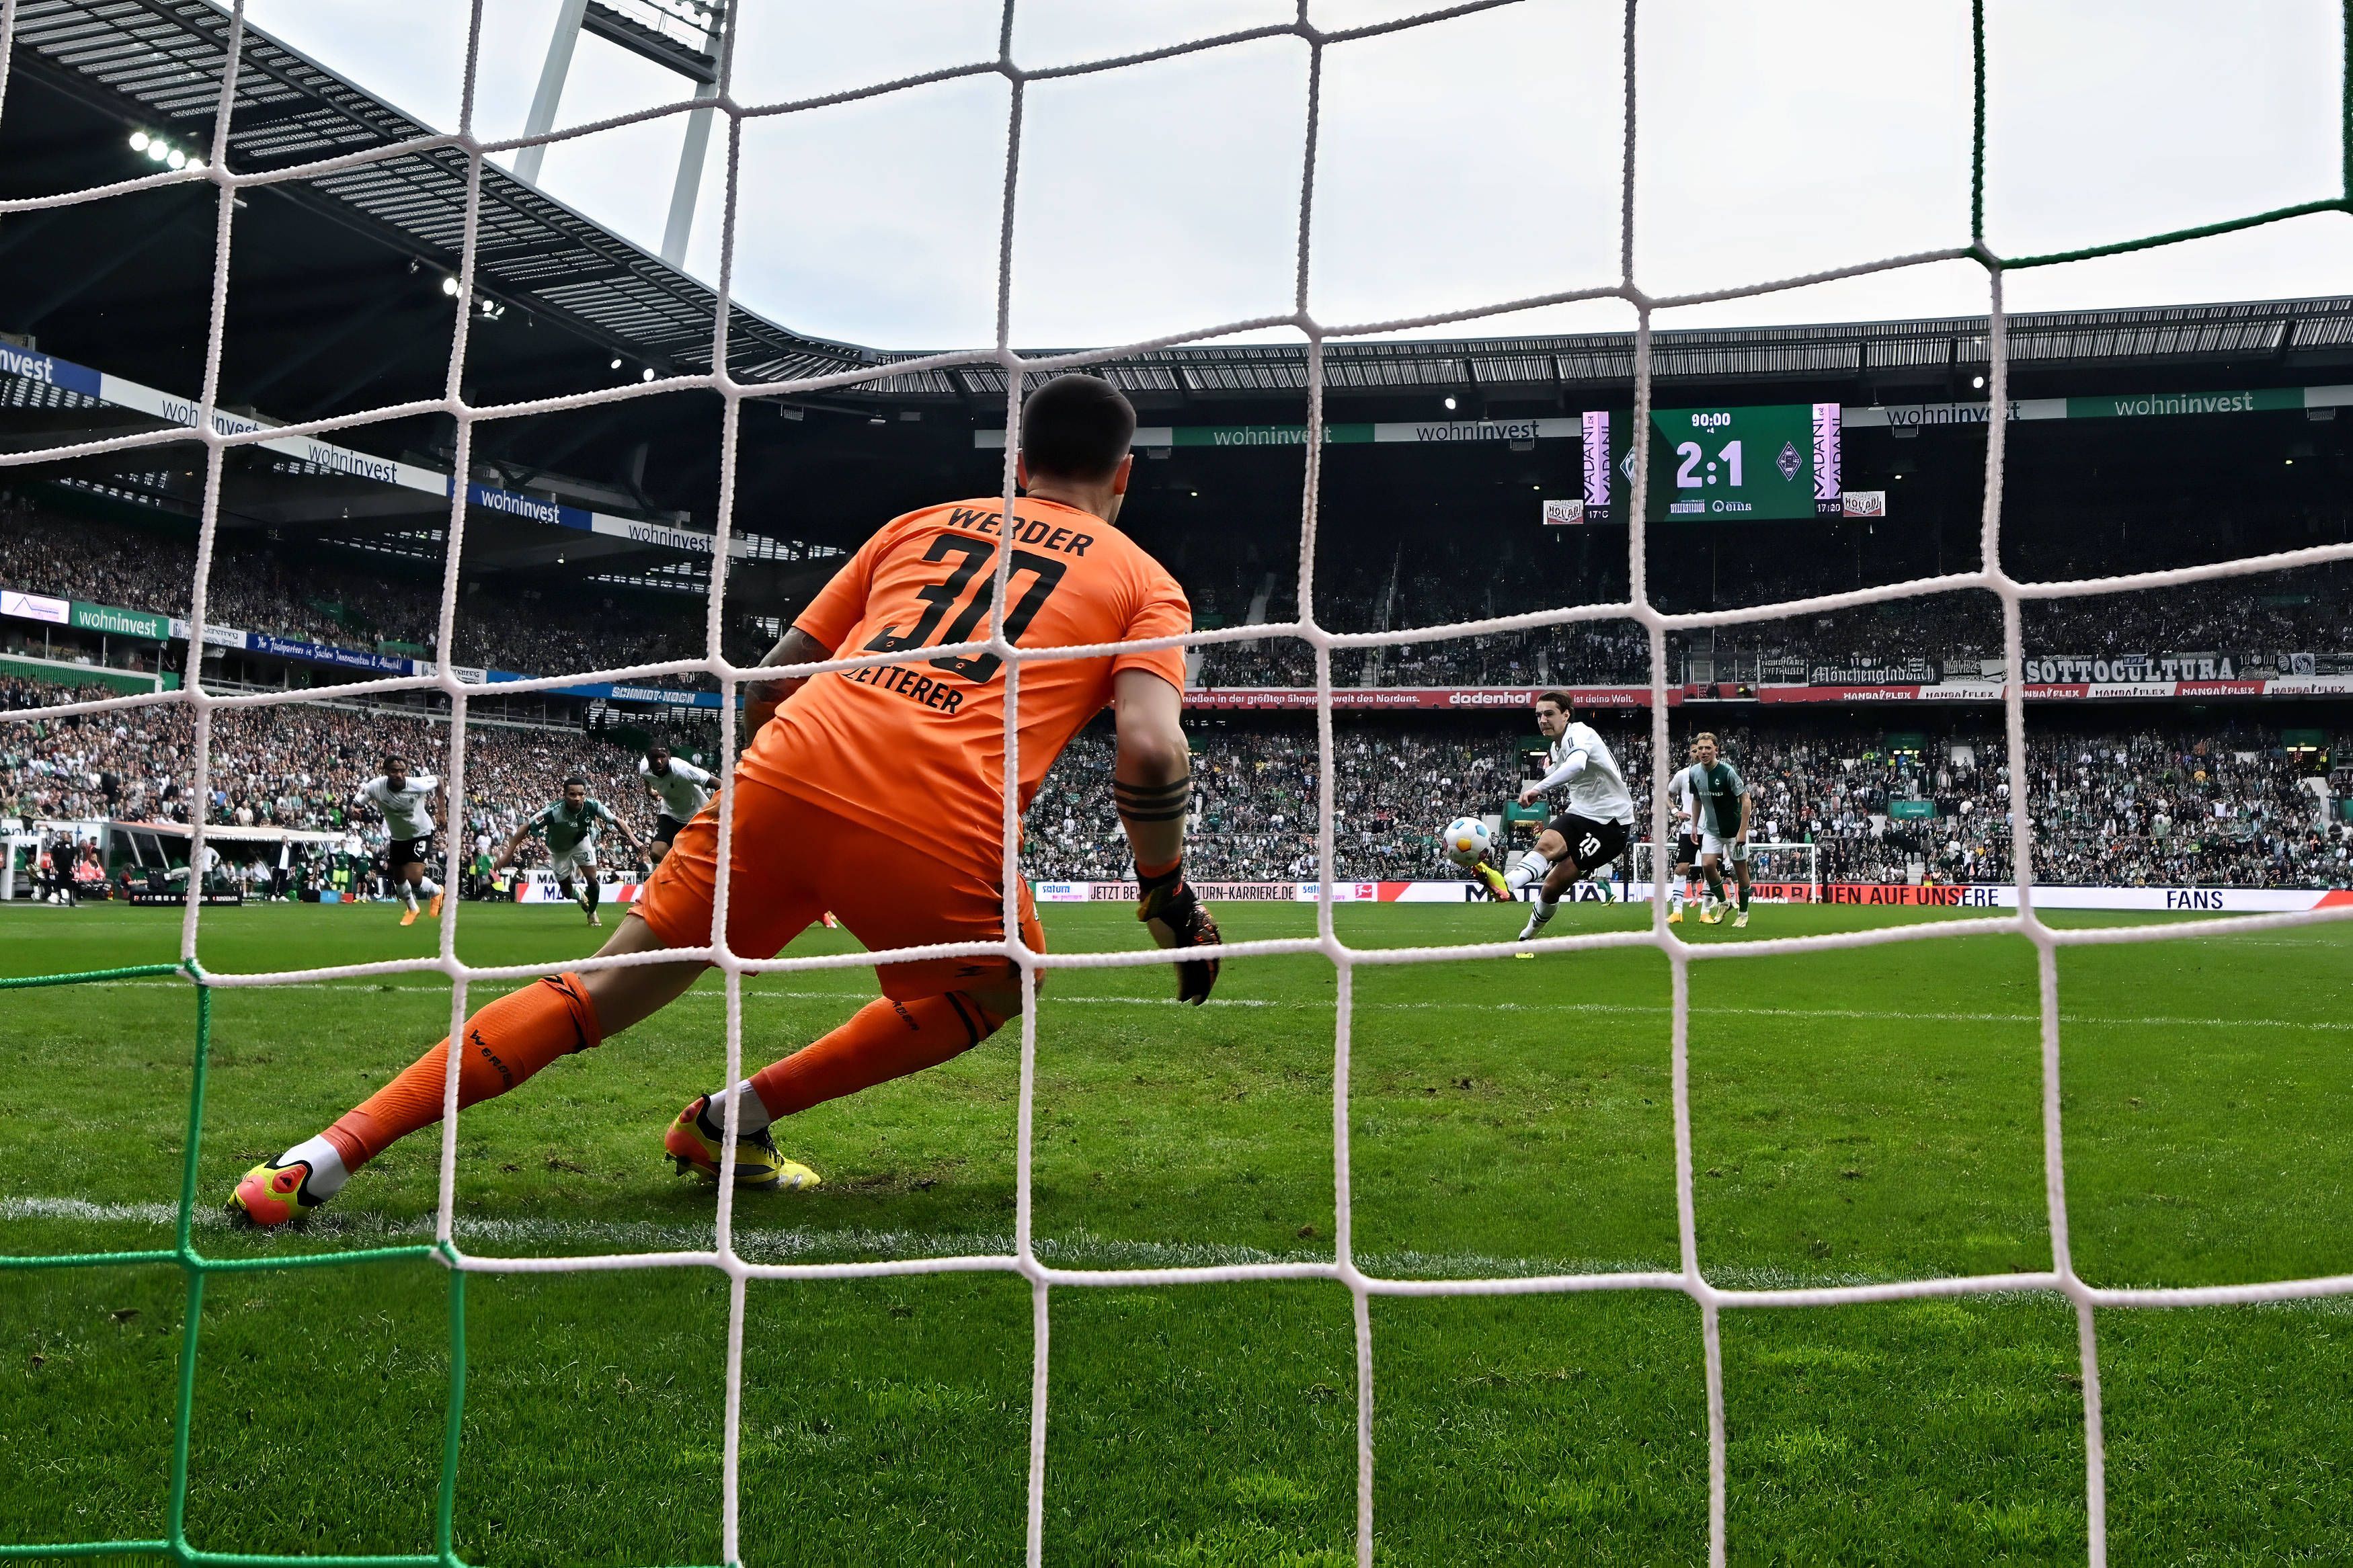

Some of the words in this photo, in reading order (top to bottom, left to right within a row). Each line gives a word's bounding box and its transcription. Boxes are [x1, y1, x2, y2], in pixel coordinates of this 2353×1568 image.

[1886, 402, 2020, 426] wohninvt
[2116, 392, 2253, 416] wohninvest
[163, 400, 260, 444] wohinvest
[1417, 419, 1540, 442] wohninvest
[1691, 413, 1730, 427] 90:00
[1214, 425, 1332, 446] wohninvet
[309, 444, 397, 483] wohninvest
[1676, 440, 1743, 488] 2:1
[481, 489, 560, 524] wohninvest
[629, 521, 712, 552] wohninvest
[948, 507, 1094, 557] WERDER
[863, 533, 1068, 684] 30
[79, 610, 157, 637] wohninvest
[2026, 657, 2235, 683] SOTTOCULTURA
[1183, 694, 1215, 703] nießen
[1218, 694, 1226, 703] in
[1229, 694, 1244, 703] der
[1449, 692, 1531, 704] dodenhof
[1579, 833, 1601, 857] 10
[1090, 886, 1119, 900] JETZT
[1195, 886, 1294, 900] TURN-KARRIERE.DE
[1870, 888, 1909, 905] AUF
[1916, 887, 1998, 906] UNSERE
[2167, 890, 2223, 909] FANS
